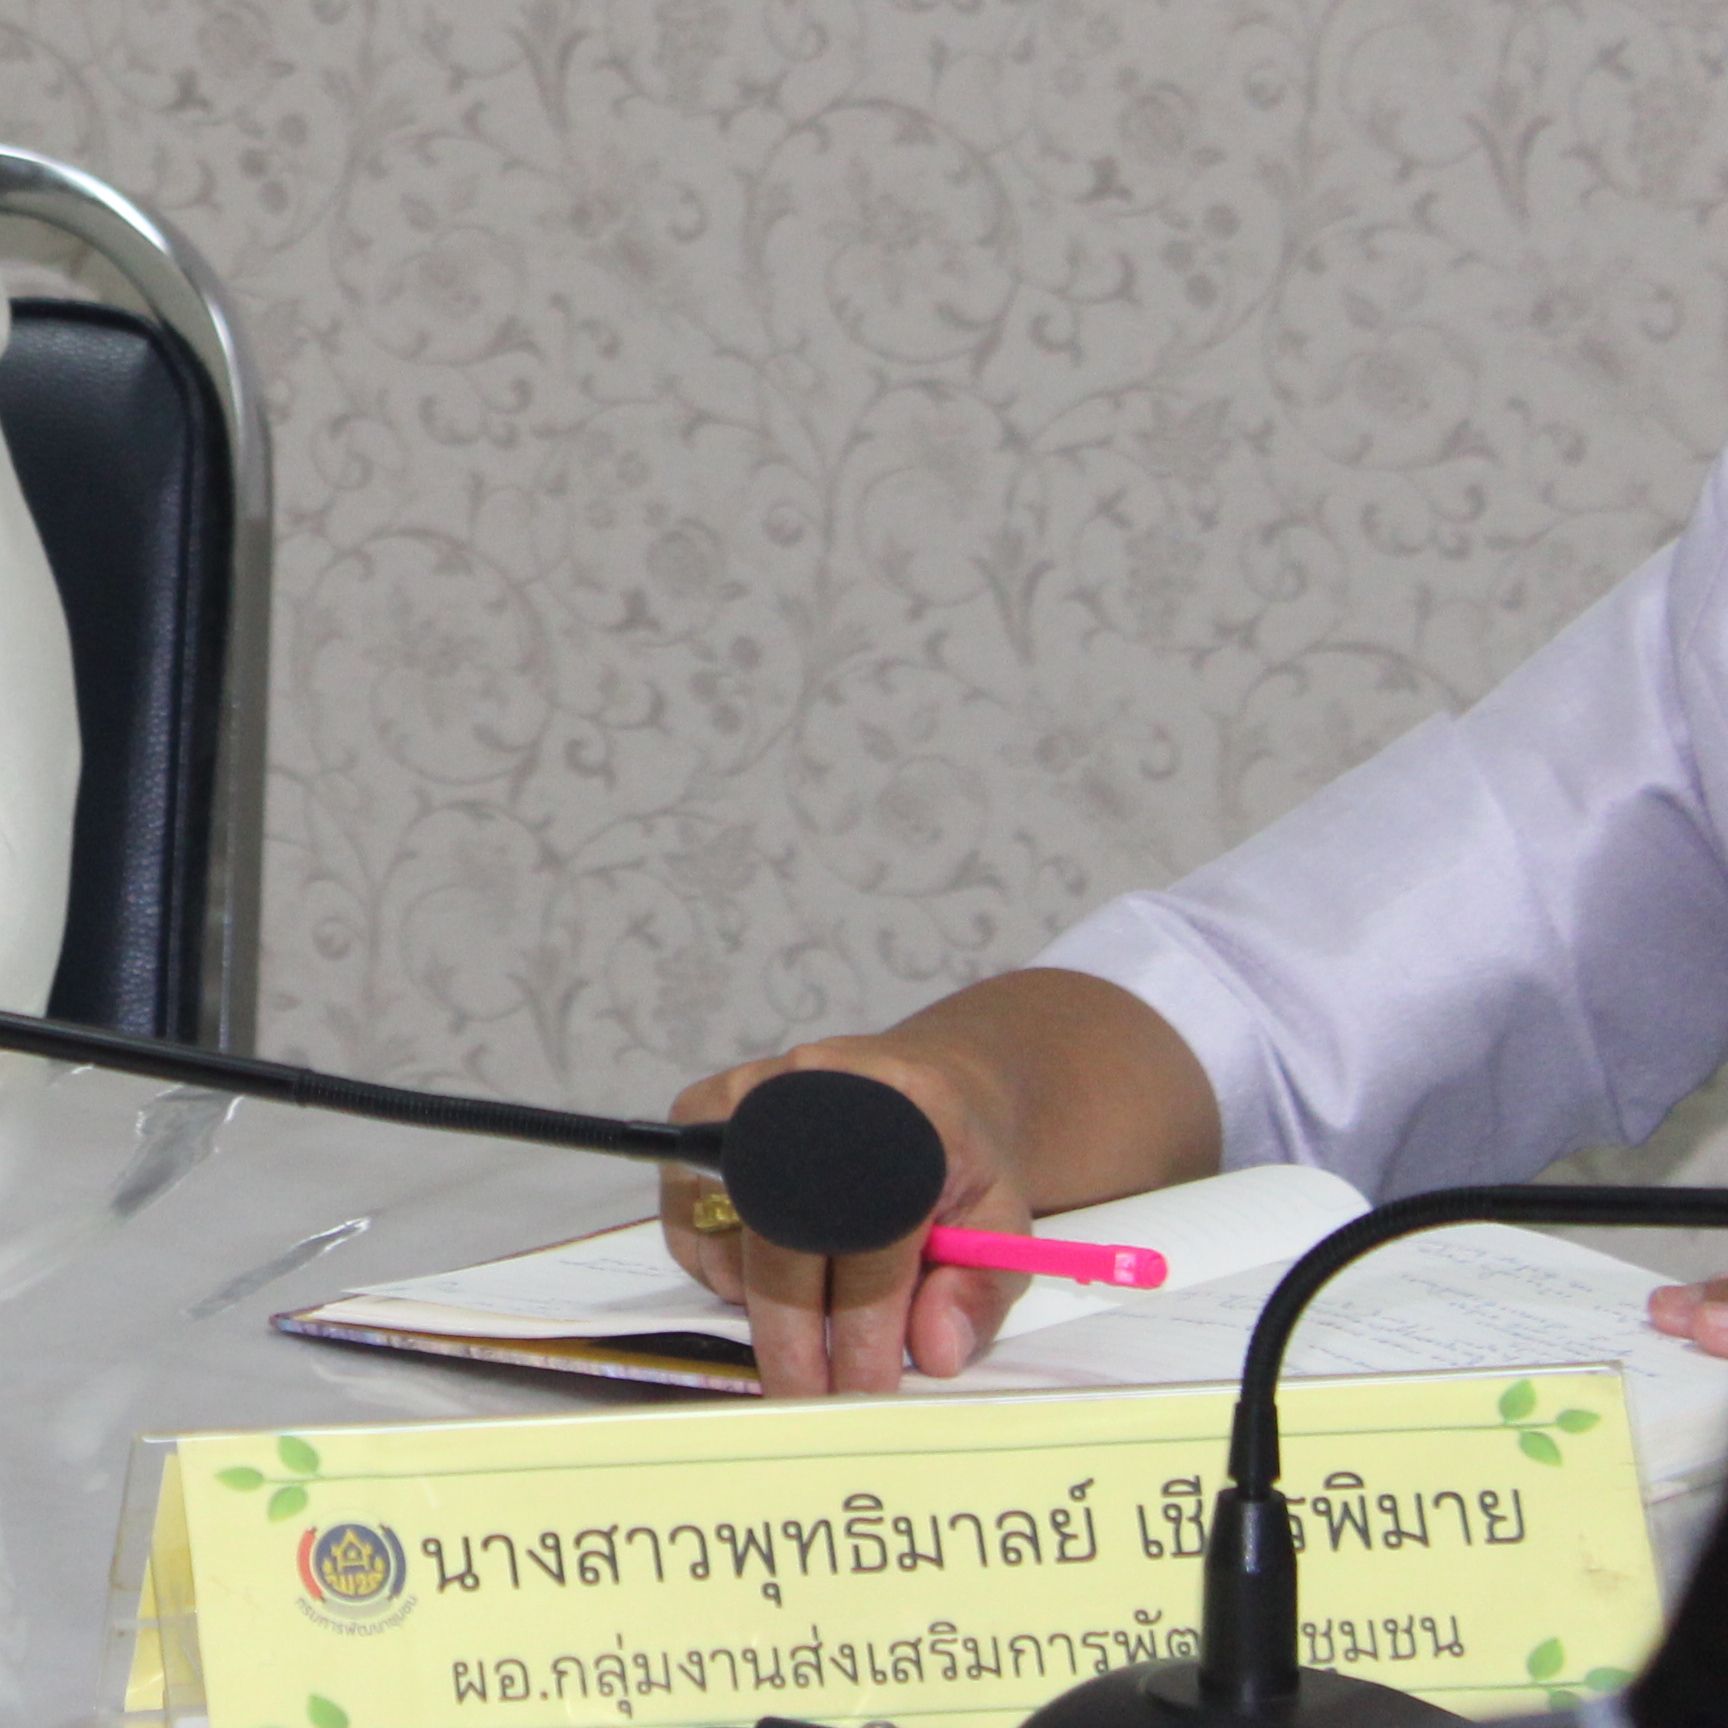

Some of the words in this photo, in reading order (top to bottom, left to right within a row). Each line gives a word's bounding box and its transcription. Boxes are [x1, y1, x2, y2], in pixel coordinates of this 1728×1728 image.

[420, 1477, 1098, 1608] นางสาวพุทธิมาลย์
